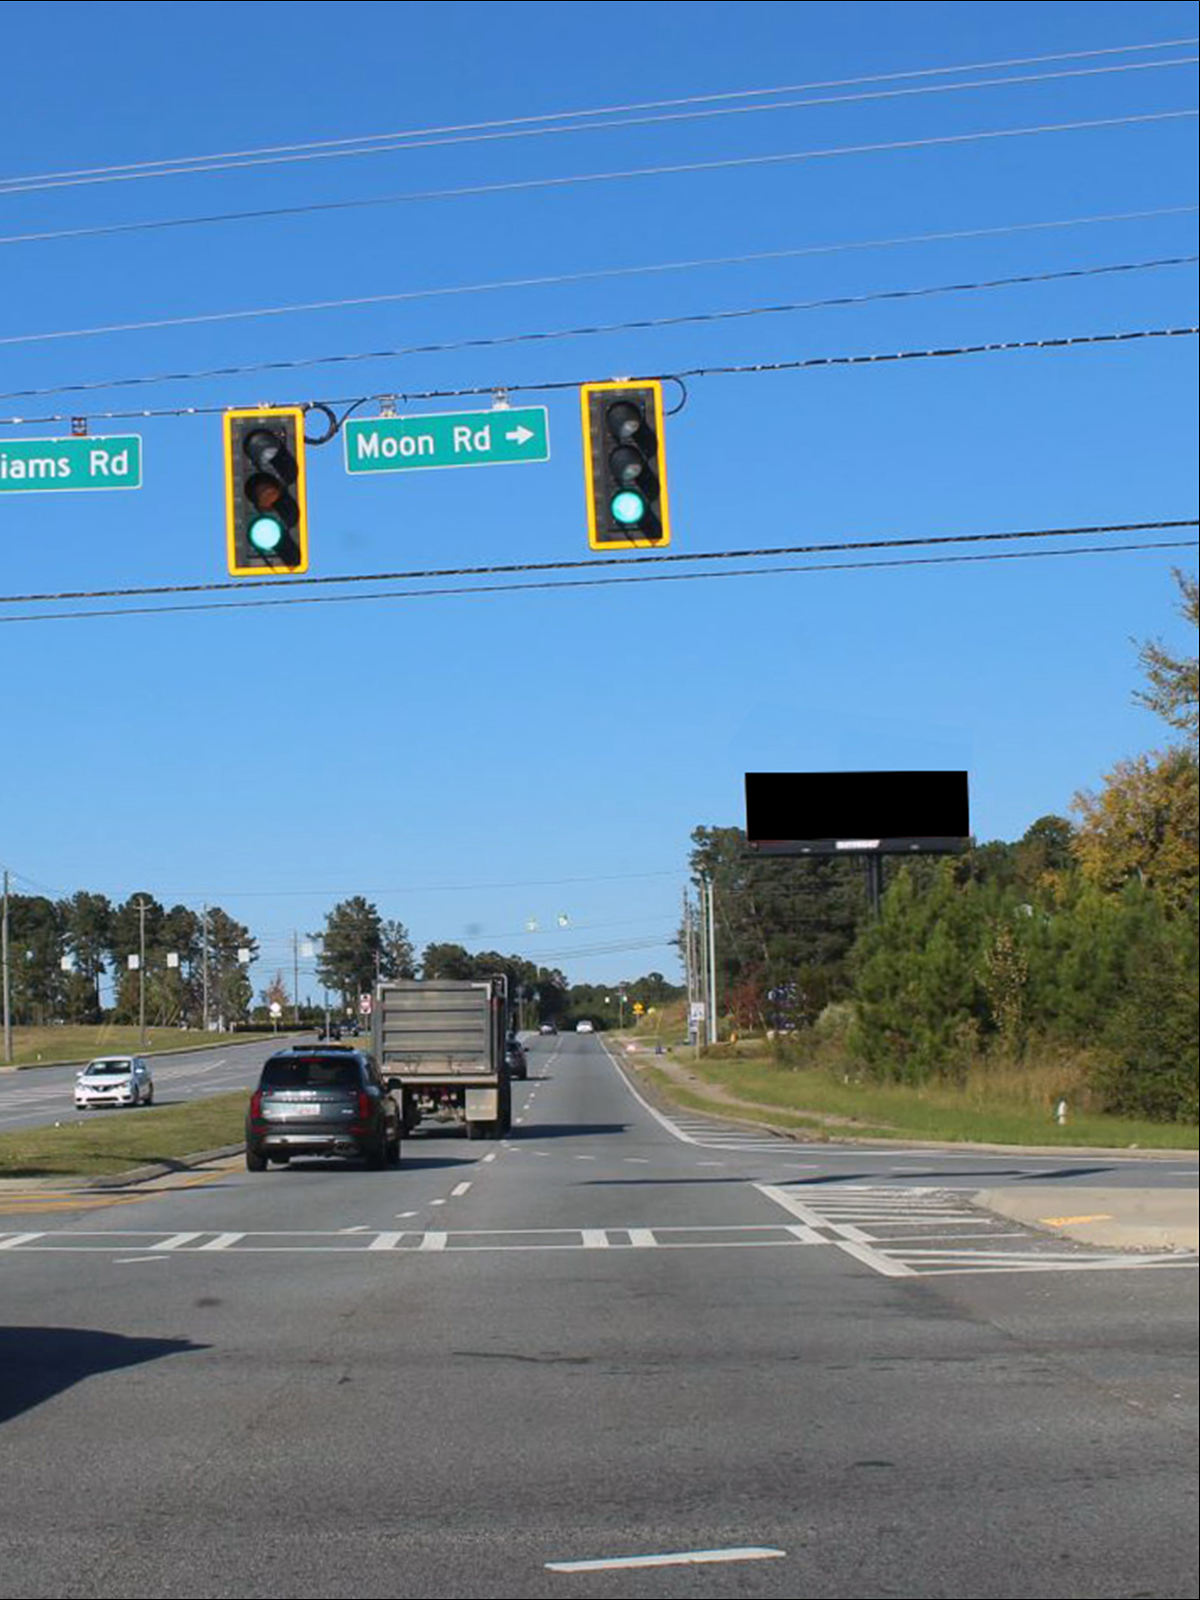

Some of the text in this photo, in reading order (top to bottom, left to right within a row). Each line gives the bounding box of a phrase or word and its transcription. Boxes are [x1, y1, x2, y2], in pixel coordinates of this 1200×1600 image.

[356, 424, 491, 460] Moon Rd
[89, 449, 128, 477] Rd
